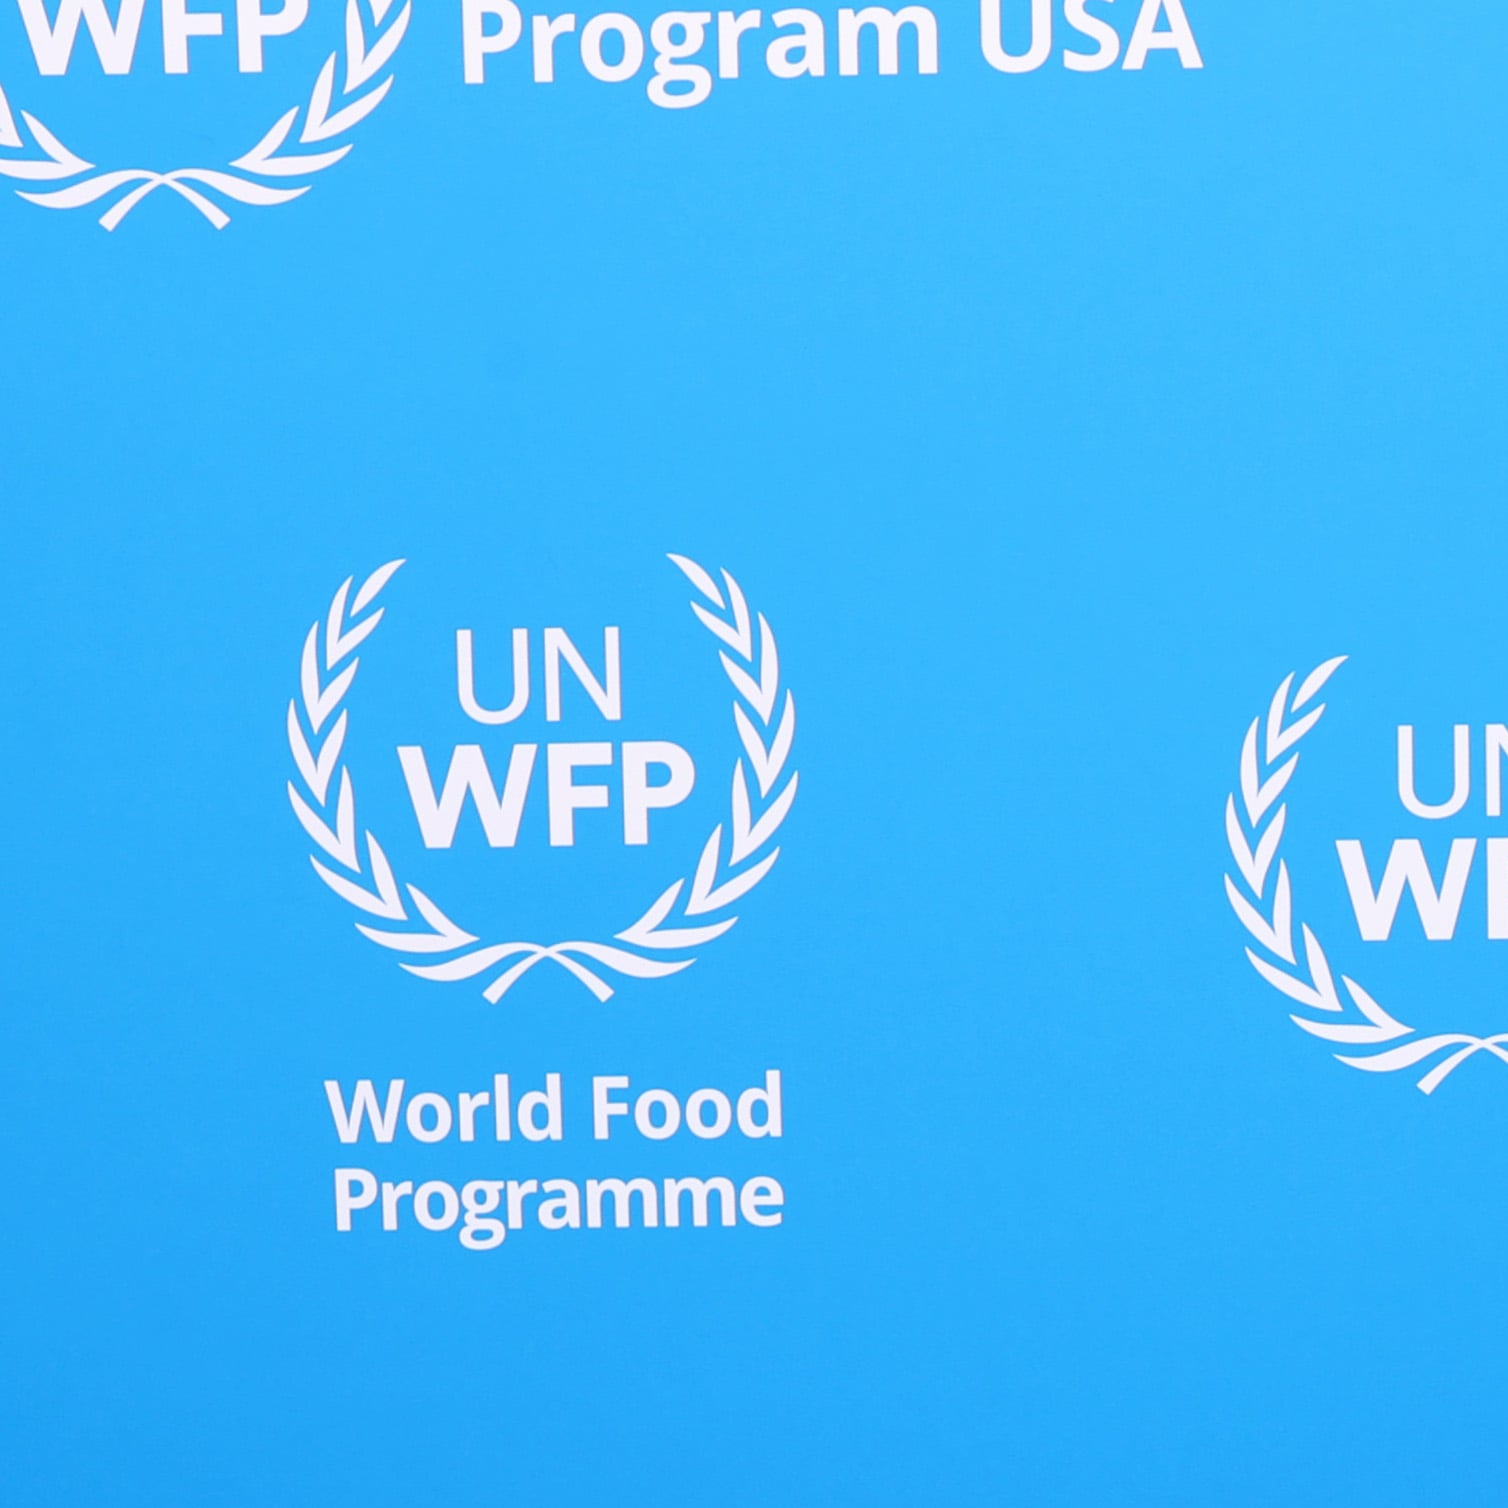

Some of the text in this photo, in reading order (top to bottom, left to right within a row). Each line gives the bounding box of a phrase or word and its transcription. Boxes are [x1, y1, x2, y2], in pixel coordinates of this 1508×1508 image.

[17, 0, 309, 76] WFP
[462, 0, 1204, 109] Program USA
[456, 626, 622, 725] UN
[397, 741, 696, 848] WFP
[324, 1070, 782, 1143] World Food
[335, 1168, 784, 1250] Programme
